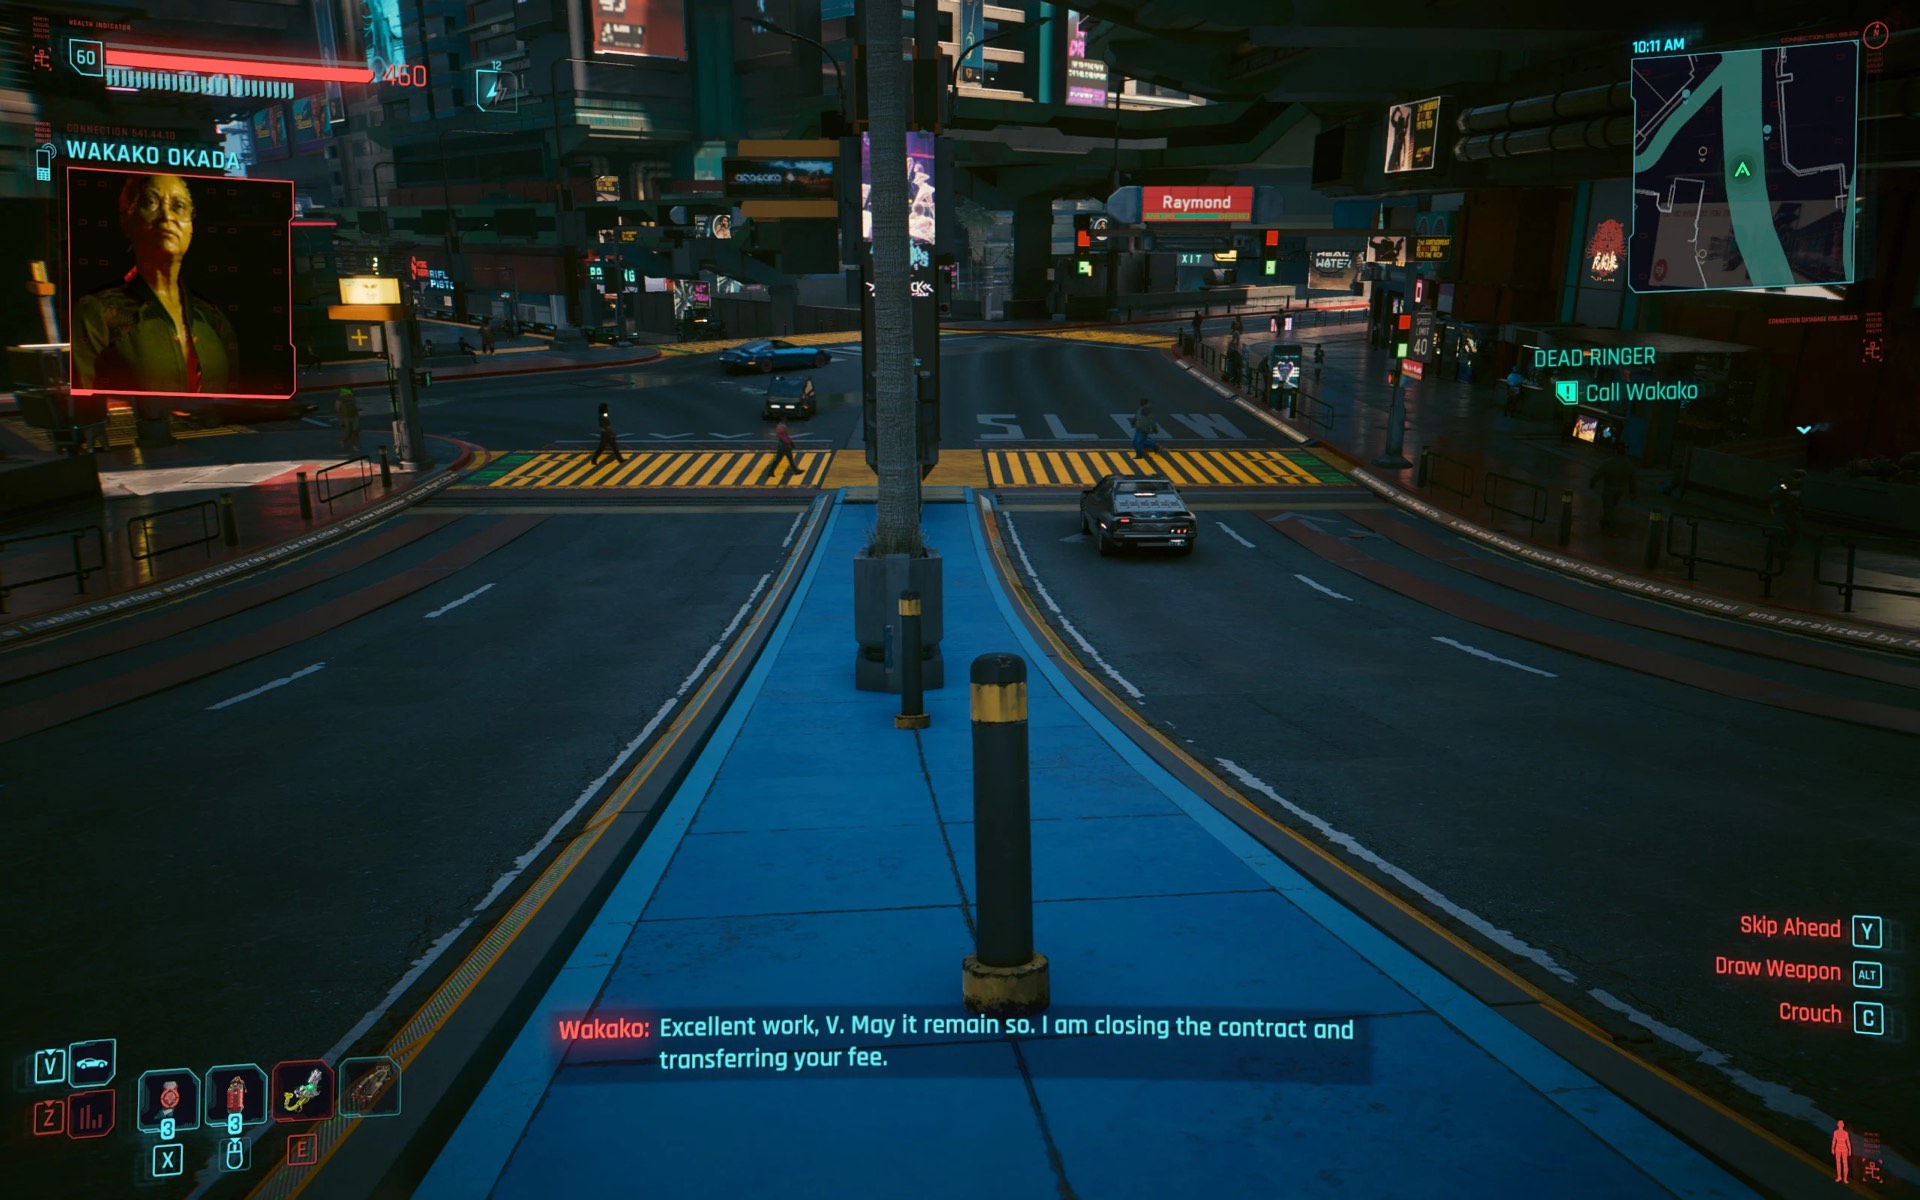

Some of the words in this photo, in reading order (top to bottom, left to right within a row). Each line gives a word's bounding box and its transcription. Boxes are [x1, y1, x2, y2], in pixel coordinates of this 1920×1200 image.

[1162, 195, 1232, 213] Raymond
[1315, 257, 1352, 269] WATER
[1415, 327, 1430, 336] LIMIT
[1413, 338, 1428, 356] 40
[1552, 557, 1581, 571] Night
[1644, 583, 1661, 593] be
[1662, 588, 1692, 601] free
[91, 604, 110, 614] to
[109, 590, 162, 610] perform
[1779, 617, 1874, 639] paralyzed
[1874, 633, 1902, 645] by
